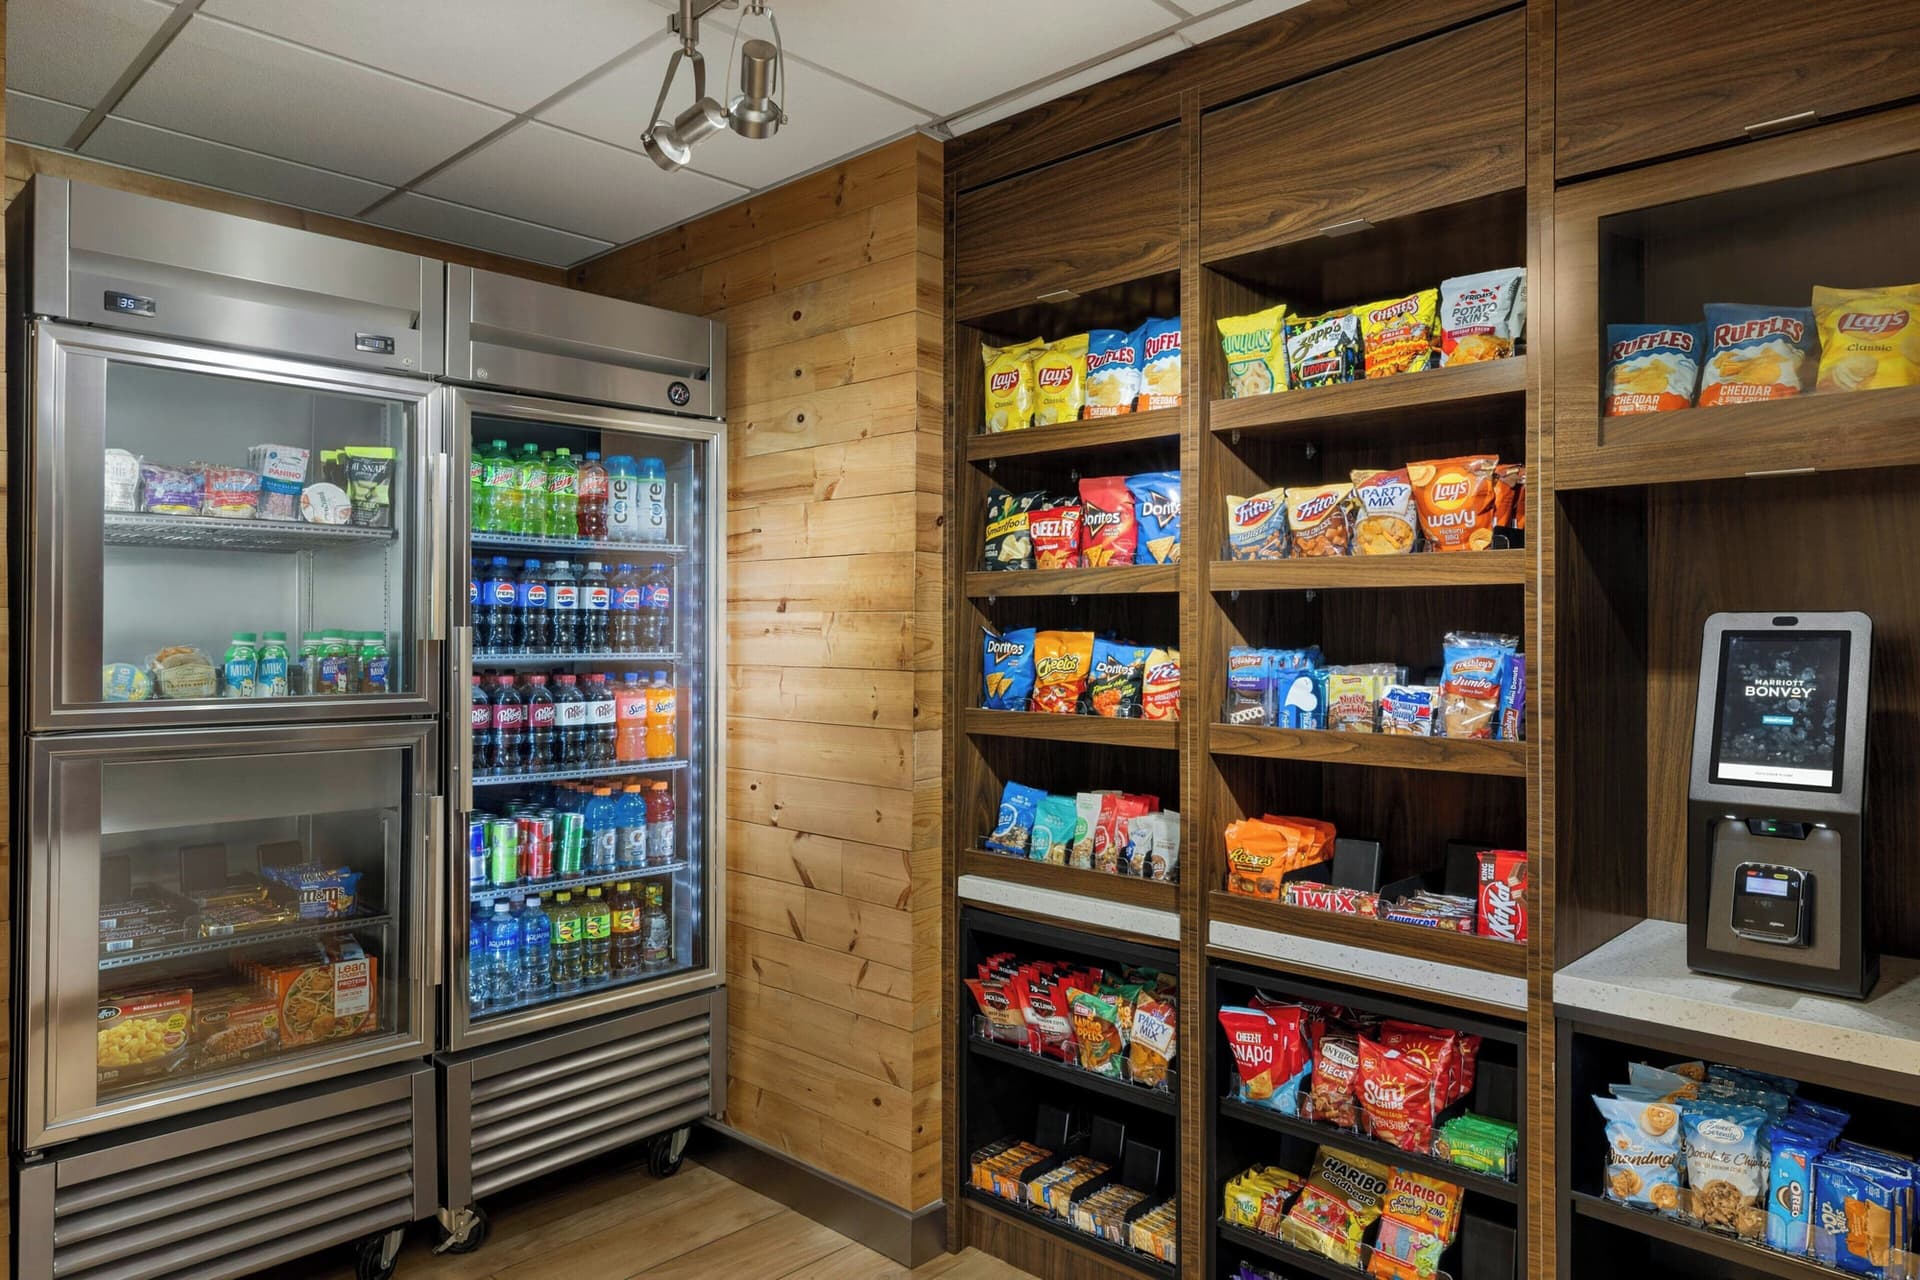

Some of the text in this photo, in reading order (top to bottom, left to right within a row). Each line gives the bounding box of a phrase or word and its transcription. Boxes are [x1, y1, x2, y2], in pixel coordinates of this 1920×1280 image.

[1369, 295, 1419, 323] CHESTER'S
[1452, 302, 1497, 317] POTATO
[1455, 312, 1491, 325] SKINS
[1713, 315, 1804, 348] RUFFLES
[1841, 310, 1908, 336] Lay's
[1144, 331, 1181, 358] RUFFL
[1609, 329, 1693, 361] RUFFLES
[1847, 342, 1893, 352] Classic
[1086, 346, 1135, 371] RUFFLES
[992, 368, 1018, 390] Lay's
[1040, 366, 1072, 386] Lay's
[1614, 394, 1660, 405] CHEDDAR
[1720, 384, 1772, 396] CHEDDAR
[268, 468, 302, 480] PANINO
[614, 479, 628, 524] core
[1361, 486, 1409, 498] PARTY
[1368, 496, 1396, 507] MIX
[1434, 481, 1468, 502] Lay's
[650, 482, 663, 526] core
[1234, 498, 1275, 526] Fritos
[1297, 494, 1338, 522] Fritos
[986, 516, 1027, 537] Smartfood
[1427, 509, 1477, 529] wavy
[529, 592, 547, 600] PEPSI
[557, 594, 576, 602] PEPSI
[987, 640, 1024, 655] Doritos
[231, 664, 252, 676] MILK
[262, 663, 282, 674] MILK
[1037, 655, 1079, 678] Cheetos
[1096, 661, 1134, 675] Doritos
[1452, 676, 1492, 688] Jumbo
[1745, 686, 1813, 698] BONVOY
[1230, 848, 1275, 867] Reese's
[1292, 885, 1356, 914] TWIX
[1138, 1013, 1168, 1035] PARTY
[1139, 1026, 1158, 1041] MIX
[1323, 1157, 1388, 1196] HARIBO
[1321, 1169, 1377, 1207] Goldbears
[1393, 1176, 1448, 1207] HARIBO
[1789, 1180, 1803, 1218] OREO
